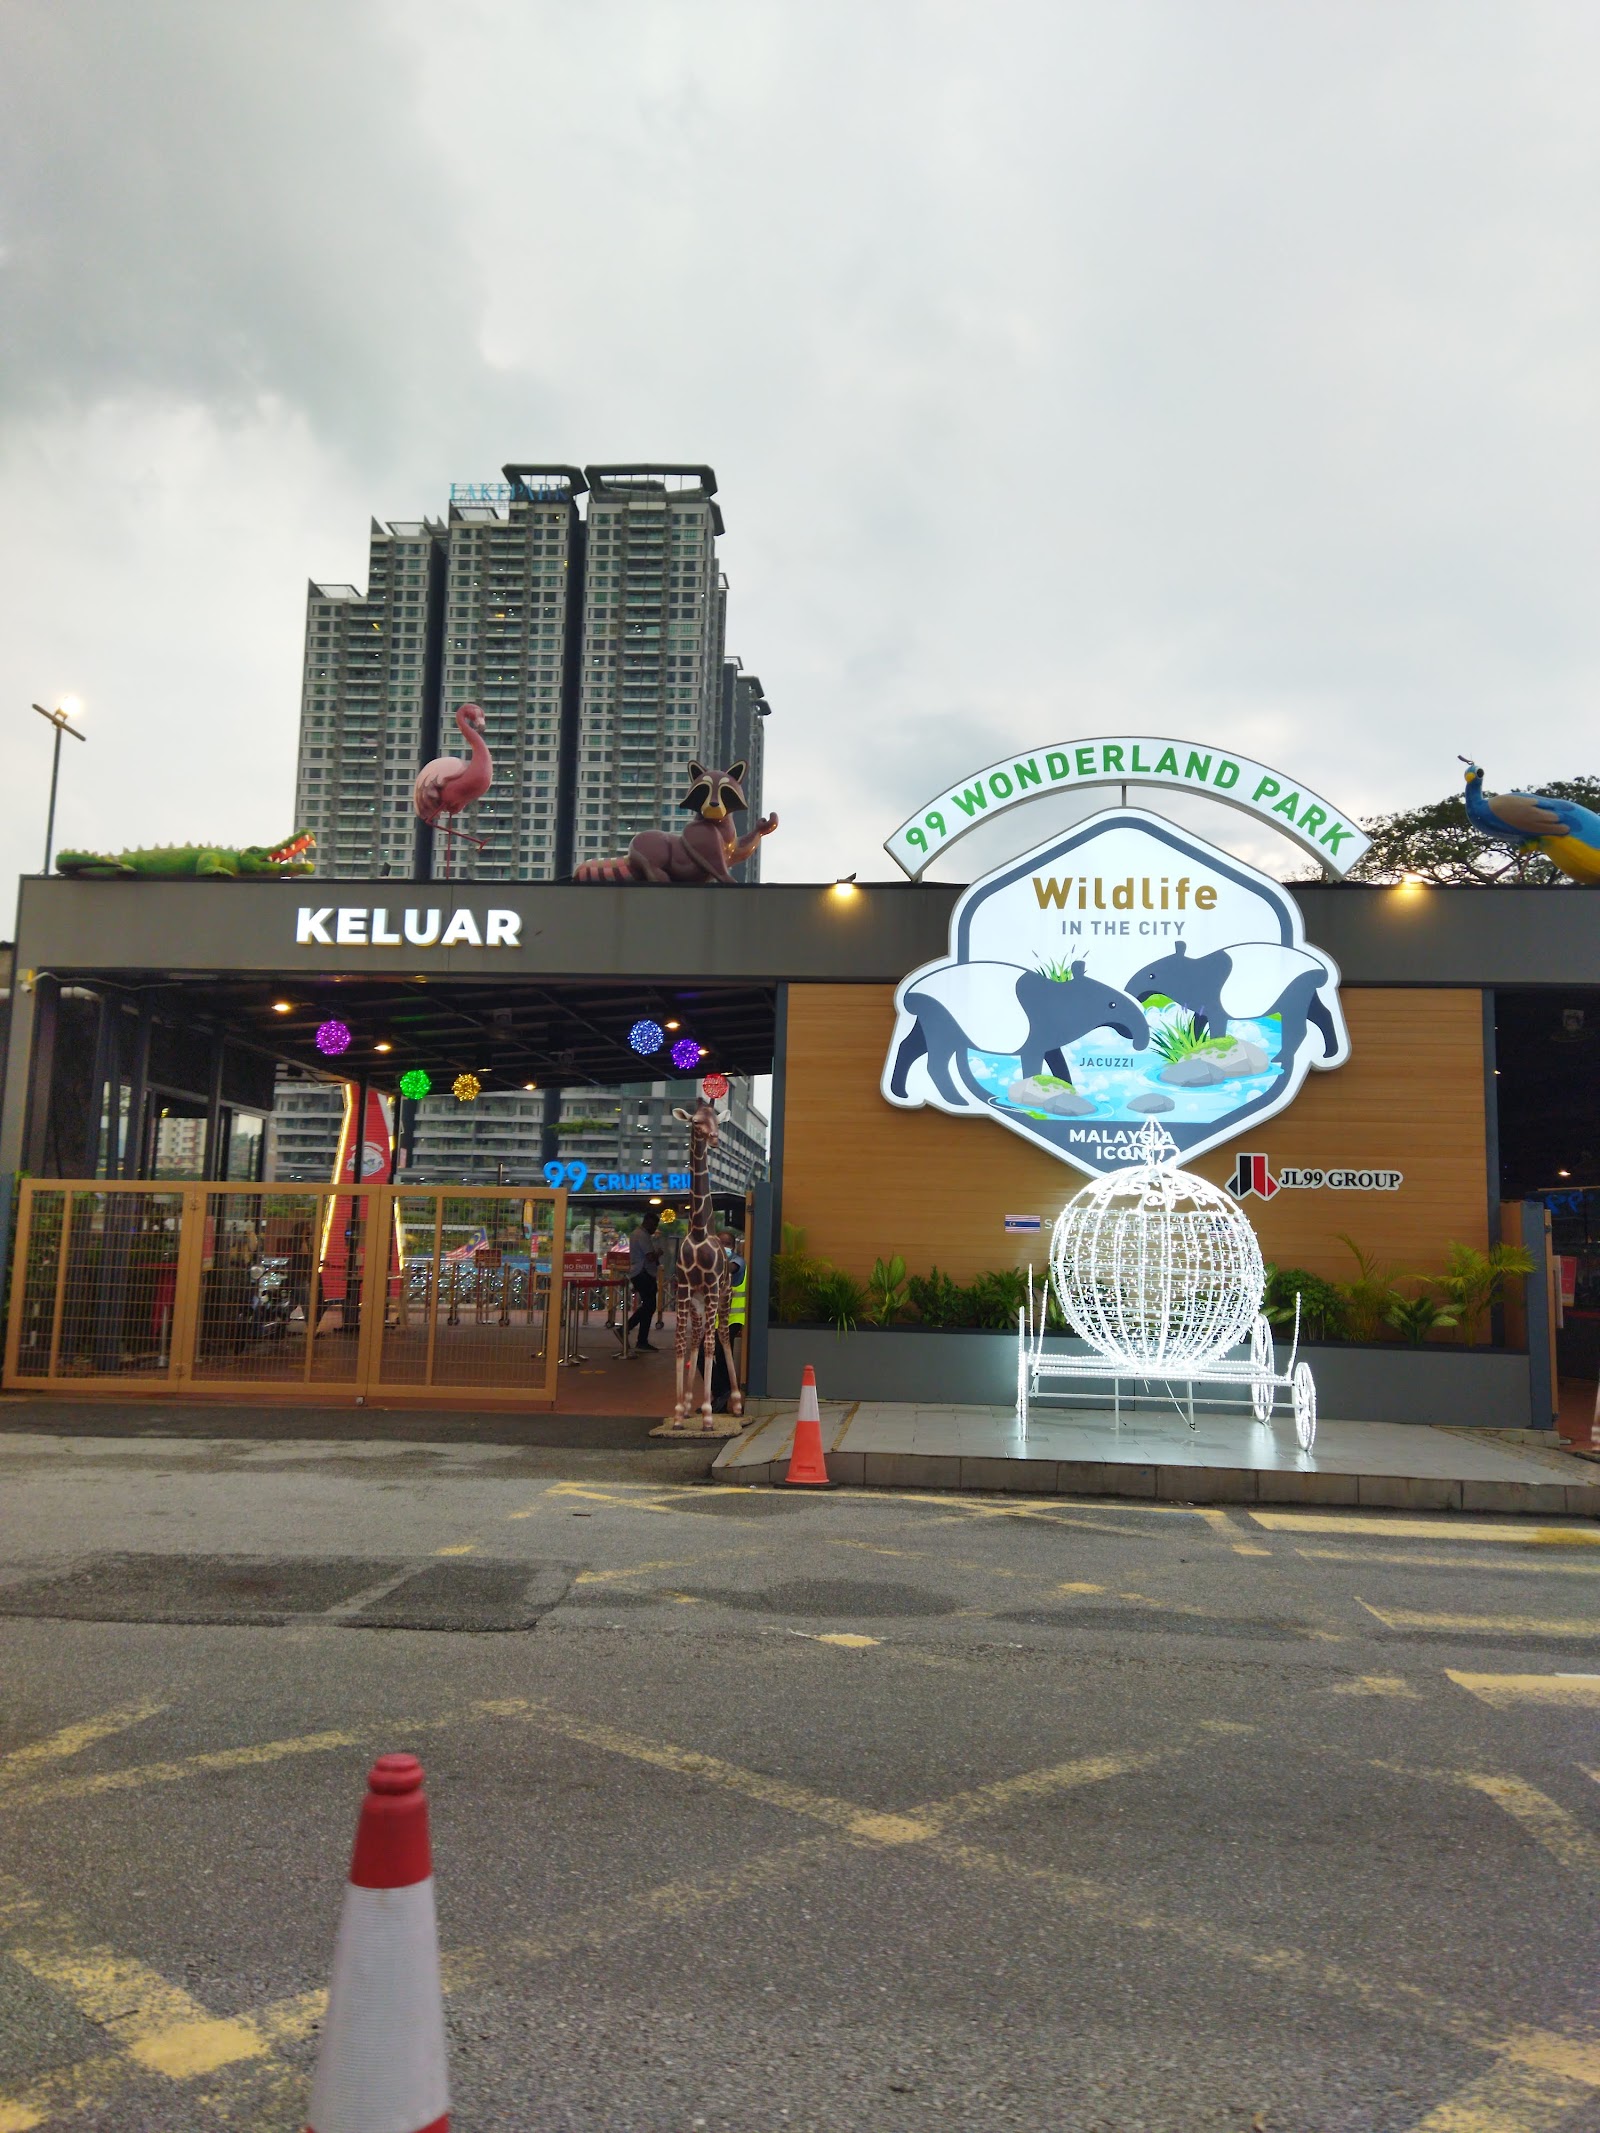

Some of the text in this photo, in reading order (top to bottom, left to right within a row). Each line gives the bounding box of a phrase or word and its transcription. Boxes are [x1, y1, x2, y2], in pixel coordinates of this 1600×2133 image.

[905, 743, 1356, 858] 99 WONDERLAND PARK
[1032, 877, 1218, 909] Wildlife
[295, 907, 522, 946] KELUAR
[1062, 921, 1185, 936] IN THE CITY
[1079, 1056, 1135, 1069] JACUZZI
[1069, 1129, 1175, 1145] MALAYSIA
[543, 1160, 588, 1192] 99
[592, 1173, 663, 1191] CRUISE
[1281, 1170, 1401, 1188] JL99 GROUP
